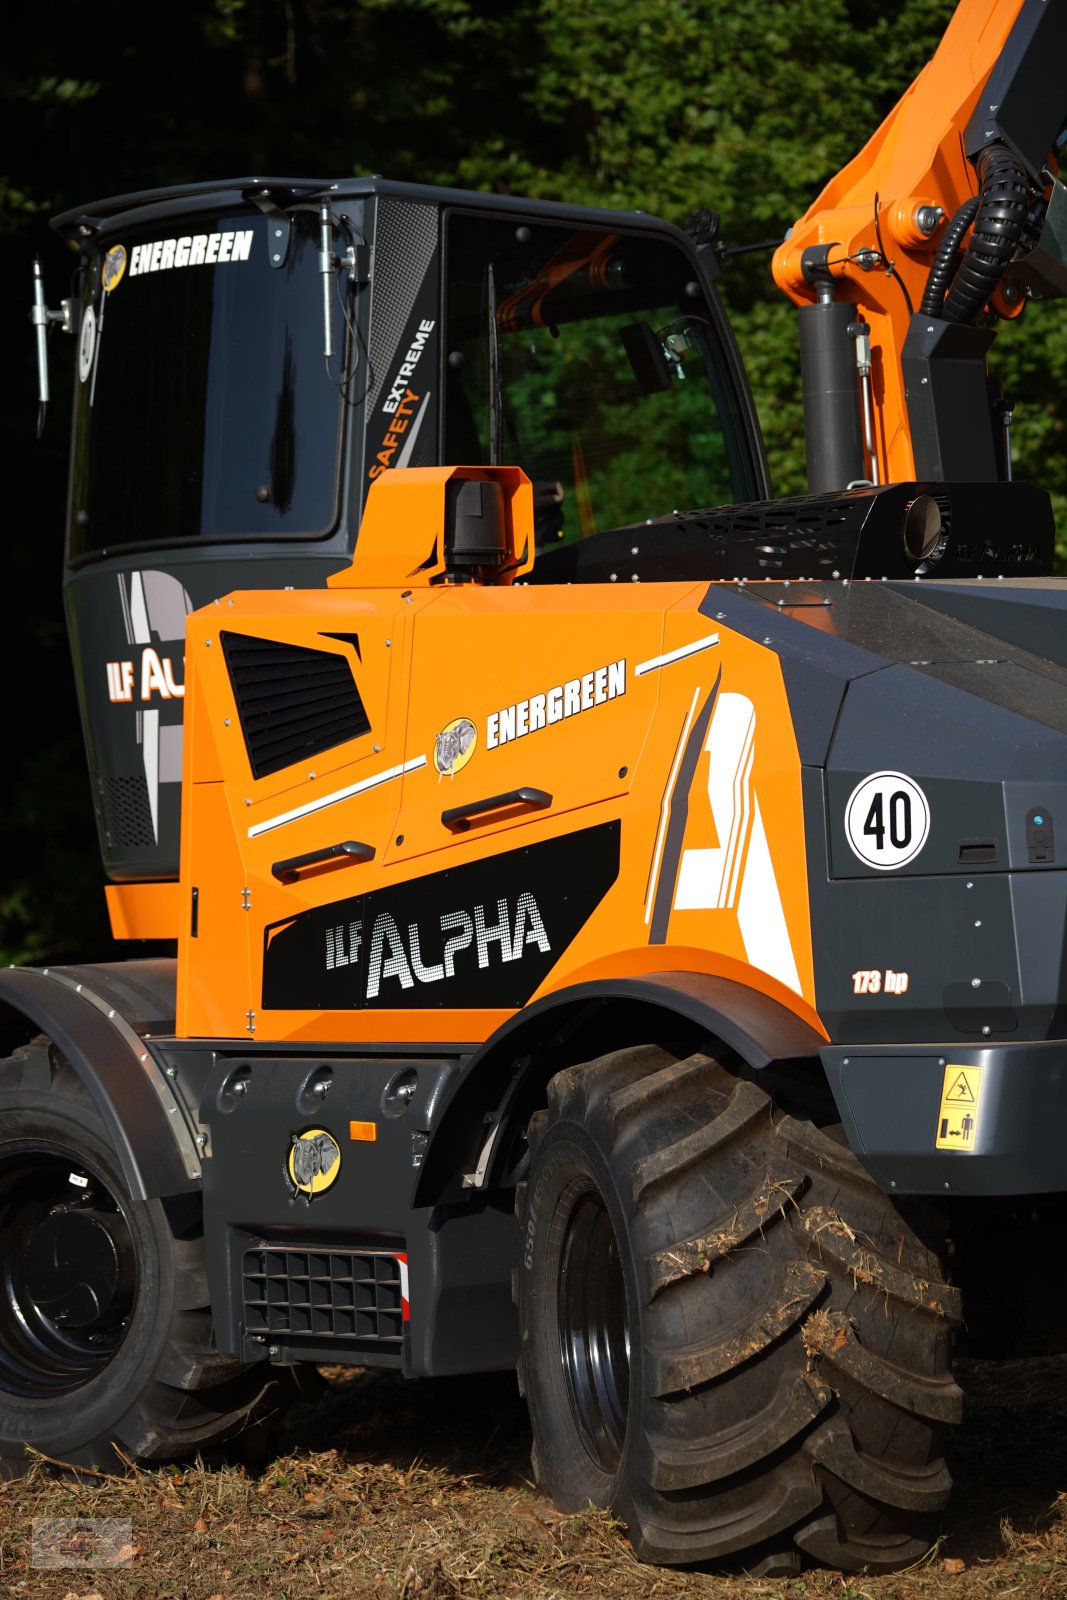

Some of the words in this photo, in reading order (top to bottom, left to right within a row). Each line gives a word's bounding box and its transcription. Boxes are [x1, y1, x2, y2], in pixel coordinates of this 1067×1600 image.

[128, 229, 254, 278] ENERGREEN
[382, 319, 436, 414] EXTREME
[368, 388, 420, 480] SAFETY
[105, 662, 134, 703] ILF
[140, 647, 186, 702] AL
[486, 658, 626, 751] ENERGREEN
[864, 790, 911, 850] 40
[325, 920, 363, 970] ILF
[366, 892, 552, 999] ALPHA
[852, 970, 881, 994] 173
[884, 970, 909, 995] hp
